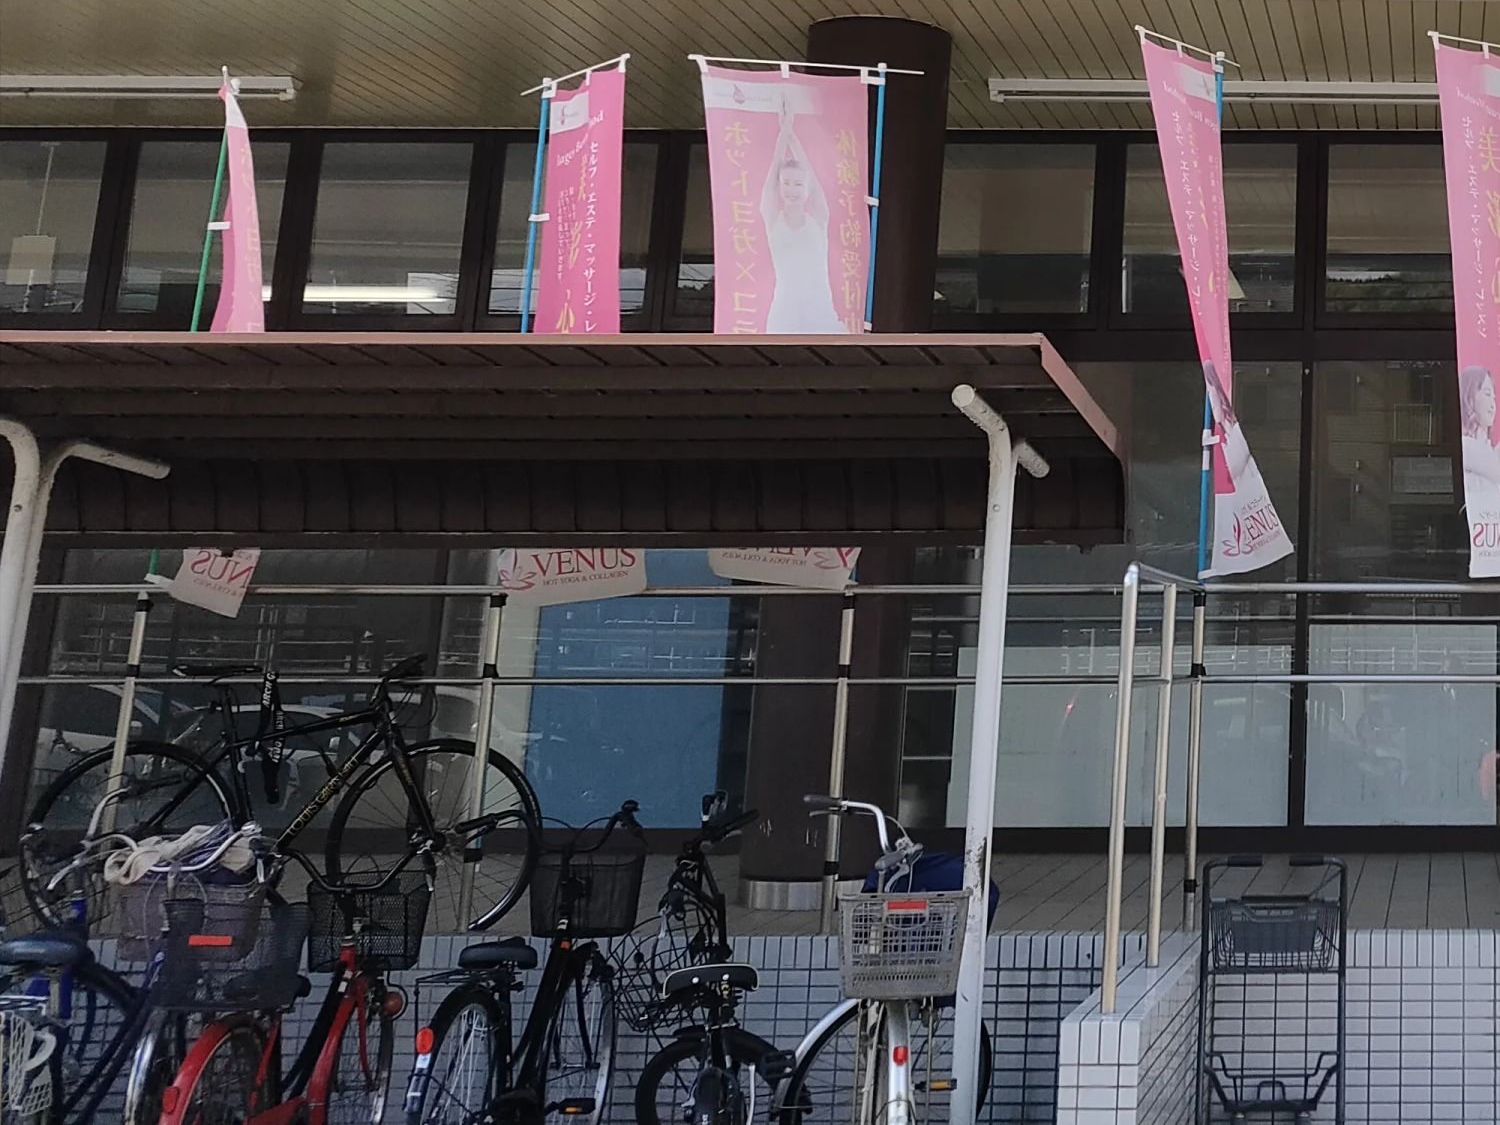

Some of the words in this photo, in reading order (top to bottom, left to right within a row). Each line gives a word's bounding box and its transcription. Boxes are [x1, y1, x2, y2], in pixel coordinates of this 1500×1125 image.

[1243, 504, 1280, 541] ENUS
[531, 548, 636, 577] VENUS
[543, 577, 559, 587] HOT
[560, 576, 580, 586] YOGA
